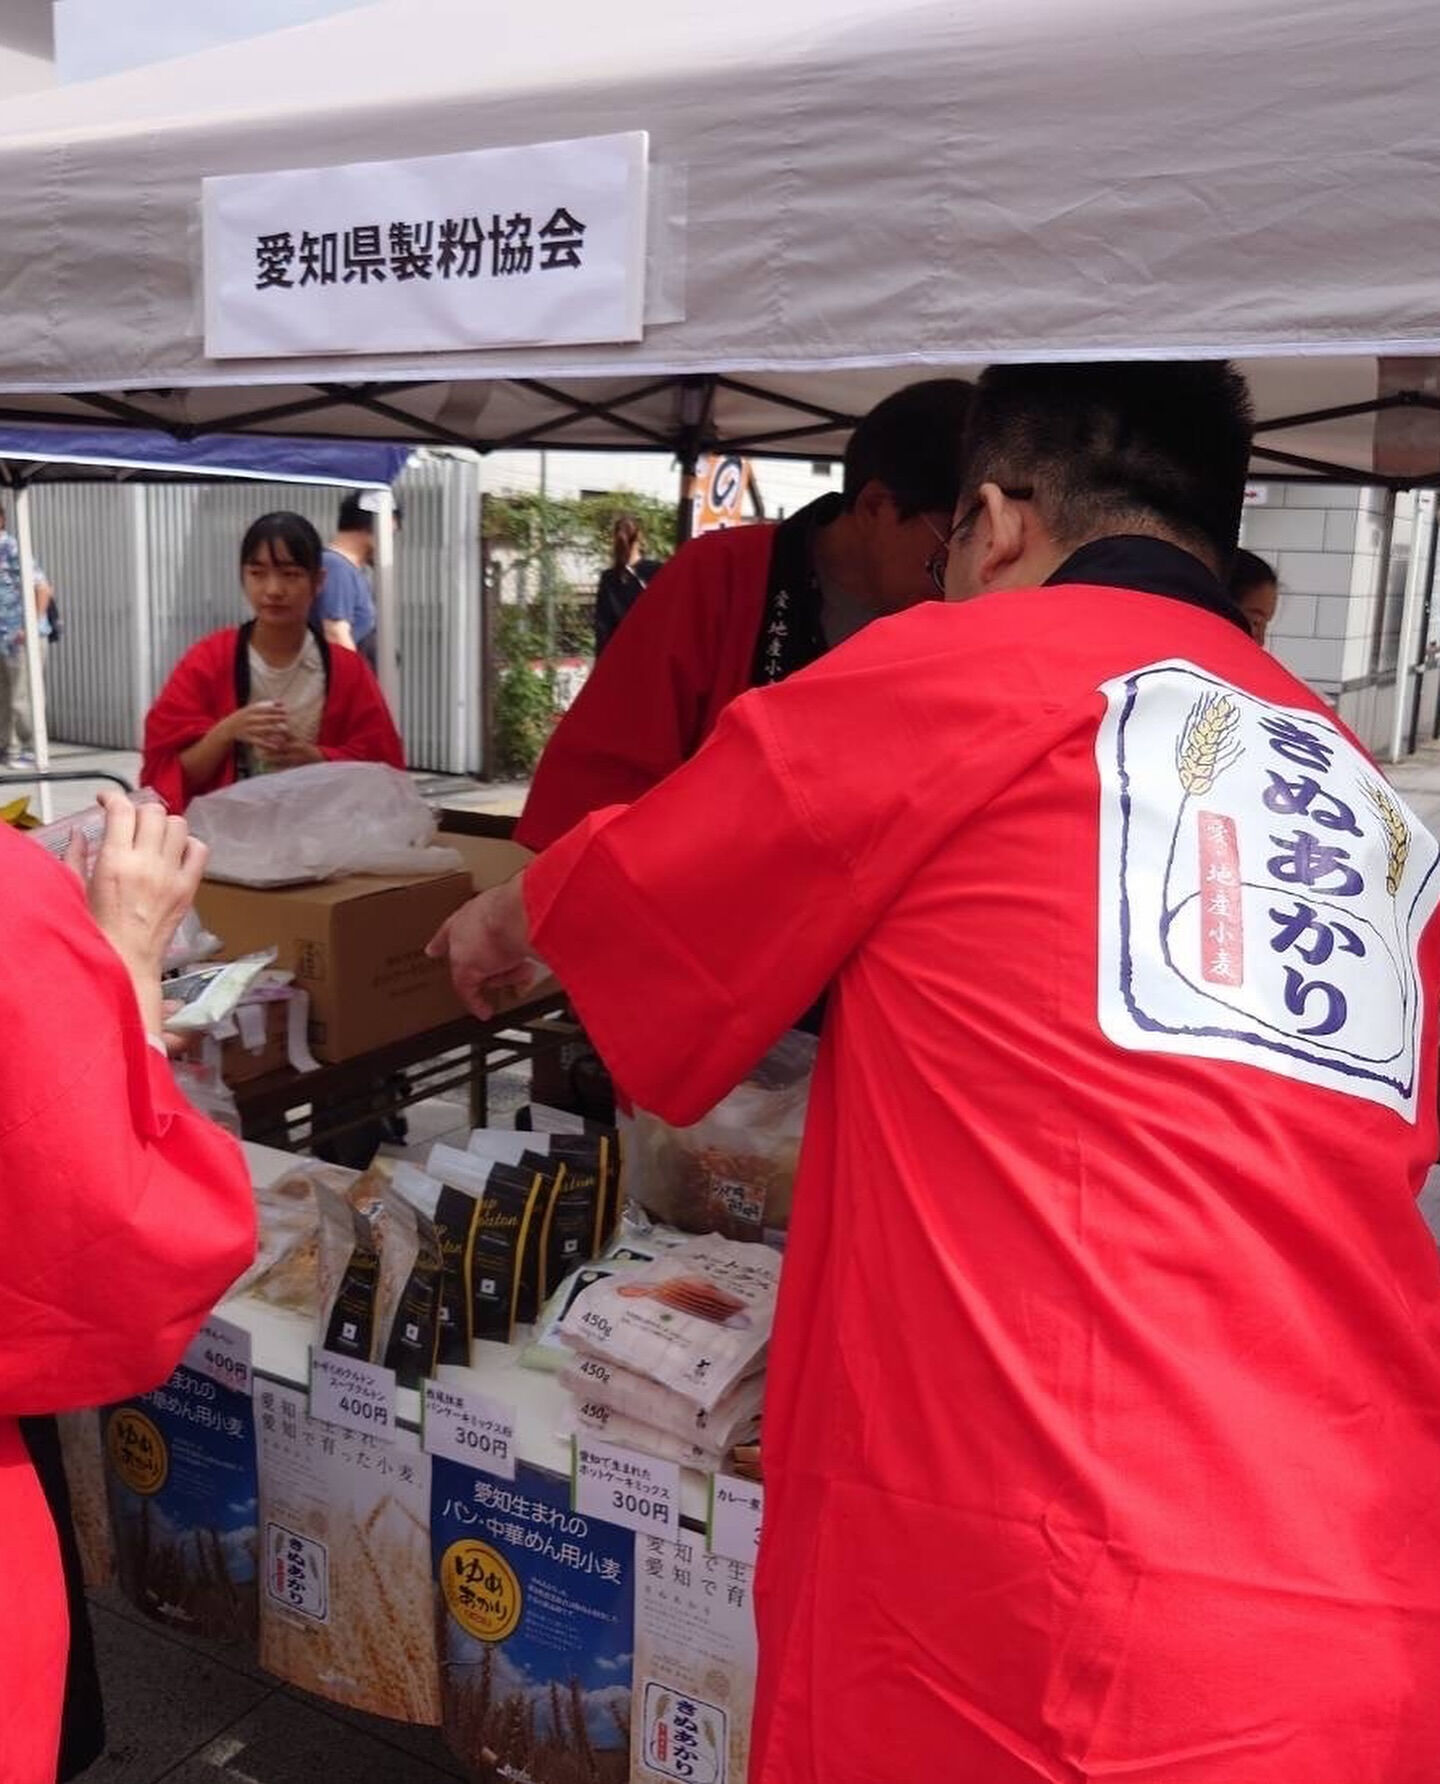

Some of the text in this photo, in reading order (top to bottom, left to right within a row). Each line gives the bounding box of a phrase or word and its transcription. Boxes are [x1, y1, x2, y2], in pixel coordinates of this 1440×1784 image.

[255, 207, 586, 290] 愛知県製粉協会
[1256, 715, 1366, 1037] きぬあかり
[582, 1312, 612, 1337] 450g
[204, 1349, 247, 1380] 400円
[580, 1361, 610, 1384] 450g
[340, 1396, 388, 1426] 400円
[581, 1402, 609, 1424] 450g
[455, 1426, 508, 1460] 300円
[579, 1450, 651, 1480] 愛知で生まれた
[579, 1464, 671, 1500] ホットケーキミックス
[473, 1480, 588, 1538] 愛知生まれの
[612, 1490, 670, 1525] 300円
[442, 1498, 623, 1585] パン・中華めん用小麦
[456, 1556, 503, 1597] ゆめ
[459, 1585, 507, 1621] あかり
[673, 1700, 699, 1777] きぬあかり
